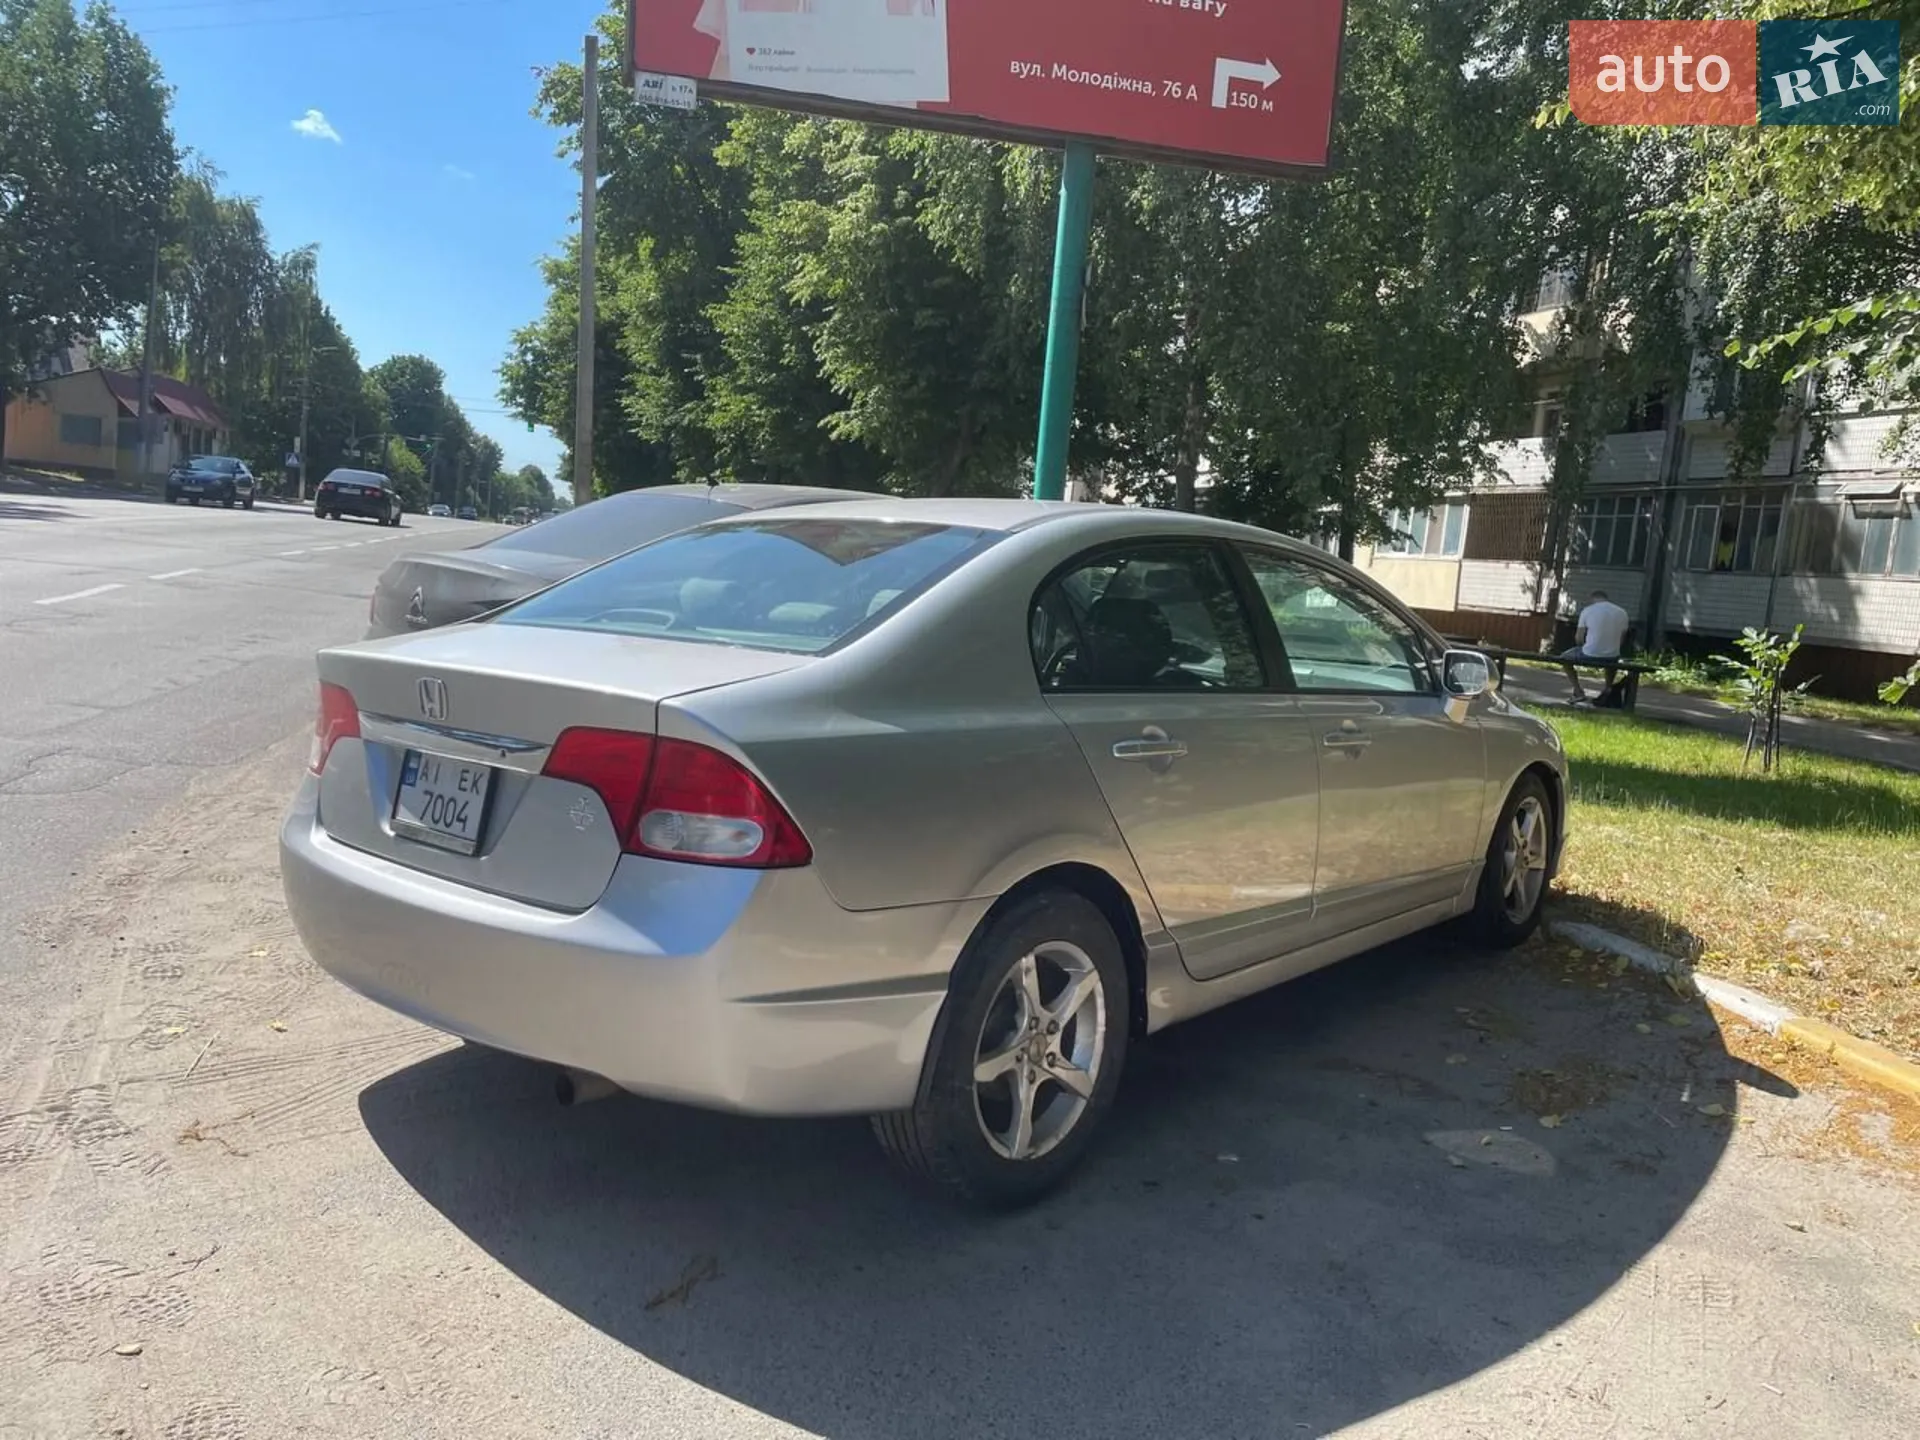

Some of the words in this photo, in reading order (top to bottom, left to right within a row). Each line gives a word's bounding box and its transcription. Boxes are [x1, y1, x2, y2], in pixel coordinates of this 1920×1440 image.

[1010, 60, 1045, 79] вул.
[1051, 62, 1156, 96] Молодіжна,
[1162, 80, 1182, 98] 76
[1186, 85, 1198, 101] А
[1230, 91, 1258, 109] 150
[1261, 100, 1273, 112] м
[419, 759, 442, 785] AI
[457, 768, 484, 796] EK
[419, 789, 470, 833] 7004
